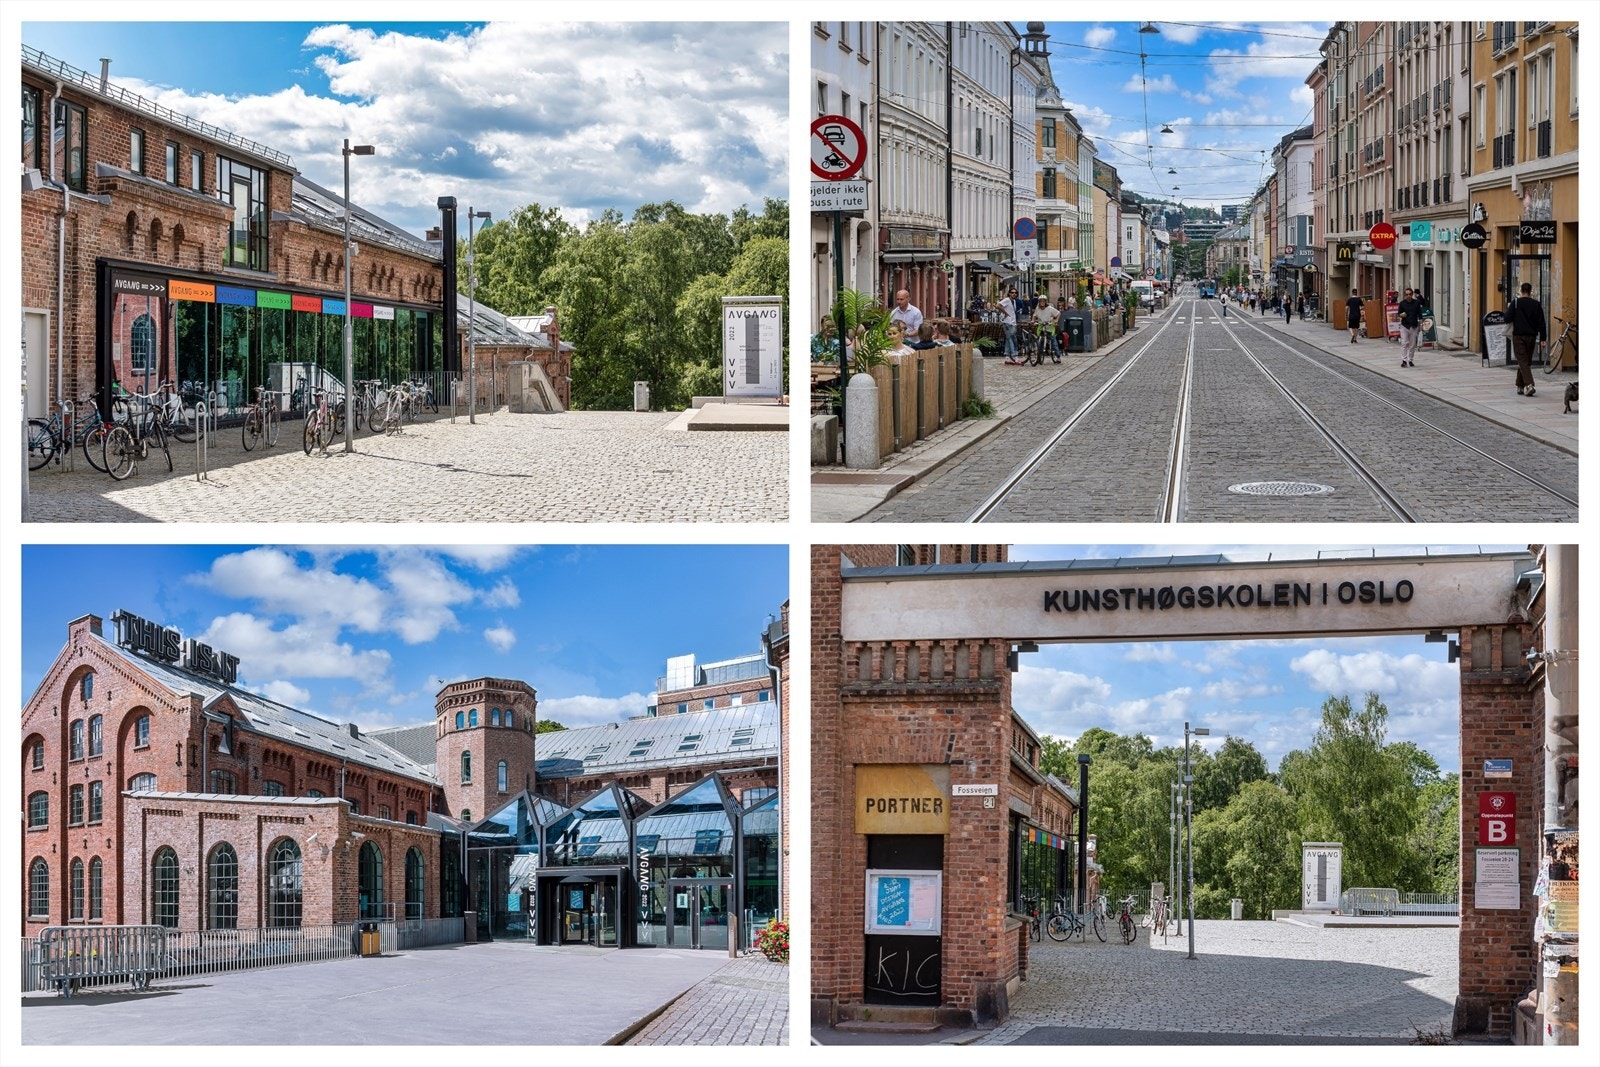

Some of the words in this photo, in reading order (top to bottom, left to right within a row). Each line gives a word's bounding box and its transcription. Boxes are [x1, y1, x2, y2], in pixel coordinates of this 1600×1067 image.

[844, 185, 864, 194] ikke
[836, 198, 839, 206] i
[843, 197, 863, 206] rute
[114, 279, 140, 290] AVGANG
[170, 286, 192, 296] AVGANG
[728, 310, 777, 318] AVGANG
[1044, 583, 1311, 612] KUNSTHØGSKOLEN
[1322, 583, 1328, 605] I
[1337, 580, 1414, 605] OSLO
[117, 609, 181, 662] THIS
[187, 638, 213, 673] IS
[957, 786, 993, 795] Fossveien
[866, 797, 943, 816] PORTNER
[1488, 820, 1507, 842] B
[640, 847, 649, 891] AVGANG
